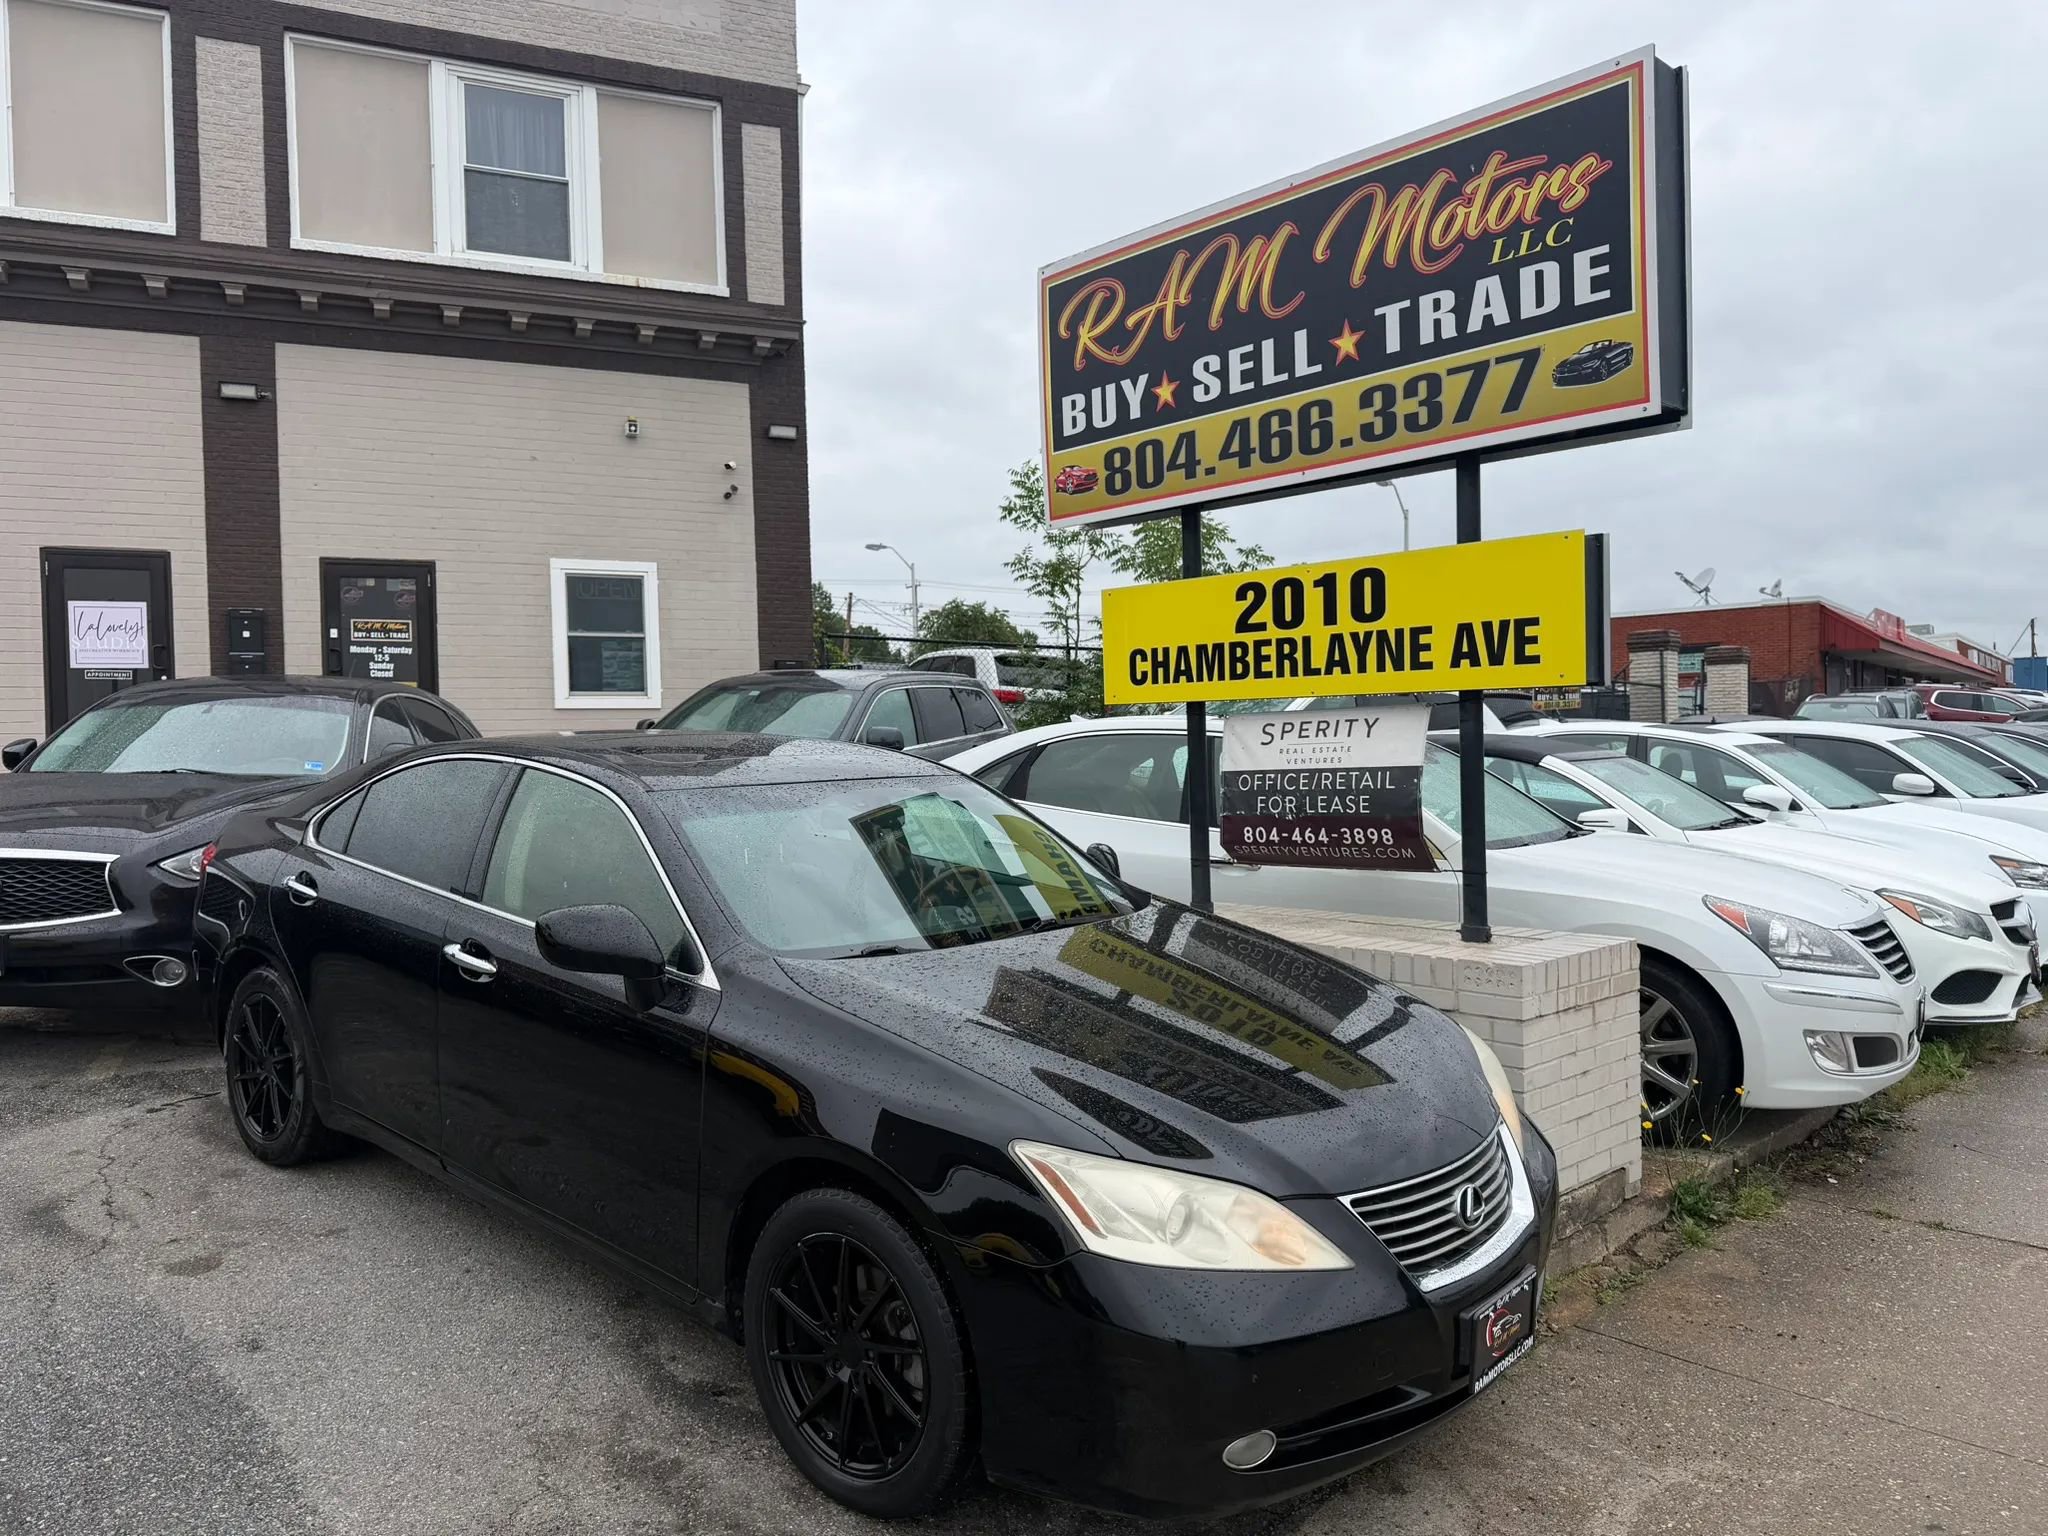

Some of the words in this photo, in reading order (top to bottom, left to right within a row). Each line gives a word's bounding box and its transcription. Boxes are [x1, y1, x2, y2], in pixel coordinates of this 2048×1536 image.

[1487, 217, 1574, 265] LLC
[1058, 221, 1305, 371] RAM
[1312, 150, 1613, 288] Motors
[1062, 371, 1150, 437] BUY
[1192, 328, 1323, 403] SELL
[1374, 244, 1611, 354] TRADE
[1103, 344, 1545, 497] 804.466.3377
[1234, 567, 1387, 634] 2010
[349, 645, 377, 654] Monday
[382, 645, 413, 655] Saturday
[1128, 624, 1434, 686] CHAMBERLAYNE
[1449, 616, 1542, 669] AVE
[369, 662, 394, 670] Sunday
[1260, 717, 1381, 746] SPERITY
[1279, 746, 1305, 755] REAL
[1312, 745, 1353, 754] ESTATE
[1286, 756, 1344, 765] VENTURES
[1238, 771, 1396, 792] OFFICE/RETAIL
[1256, 796, 1297, 814] FOR
[1306, 795, 1371, 814] LEASE
[1243, 826, 1395, 846] 804-464-3898
[1234, 844, 1417, 860] SPERITYVENTURES.COM
